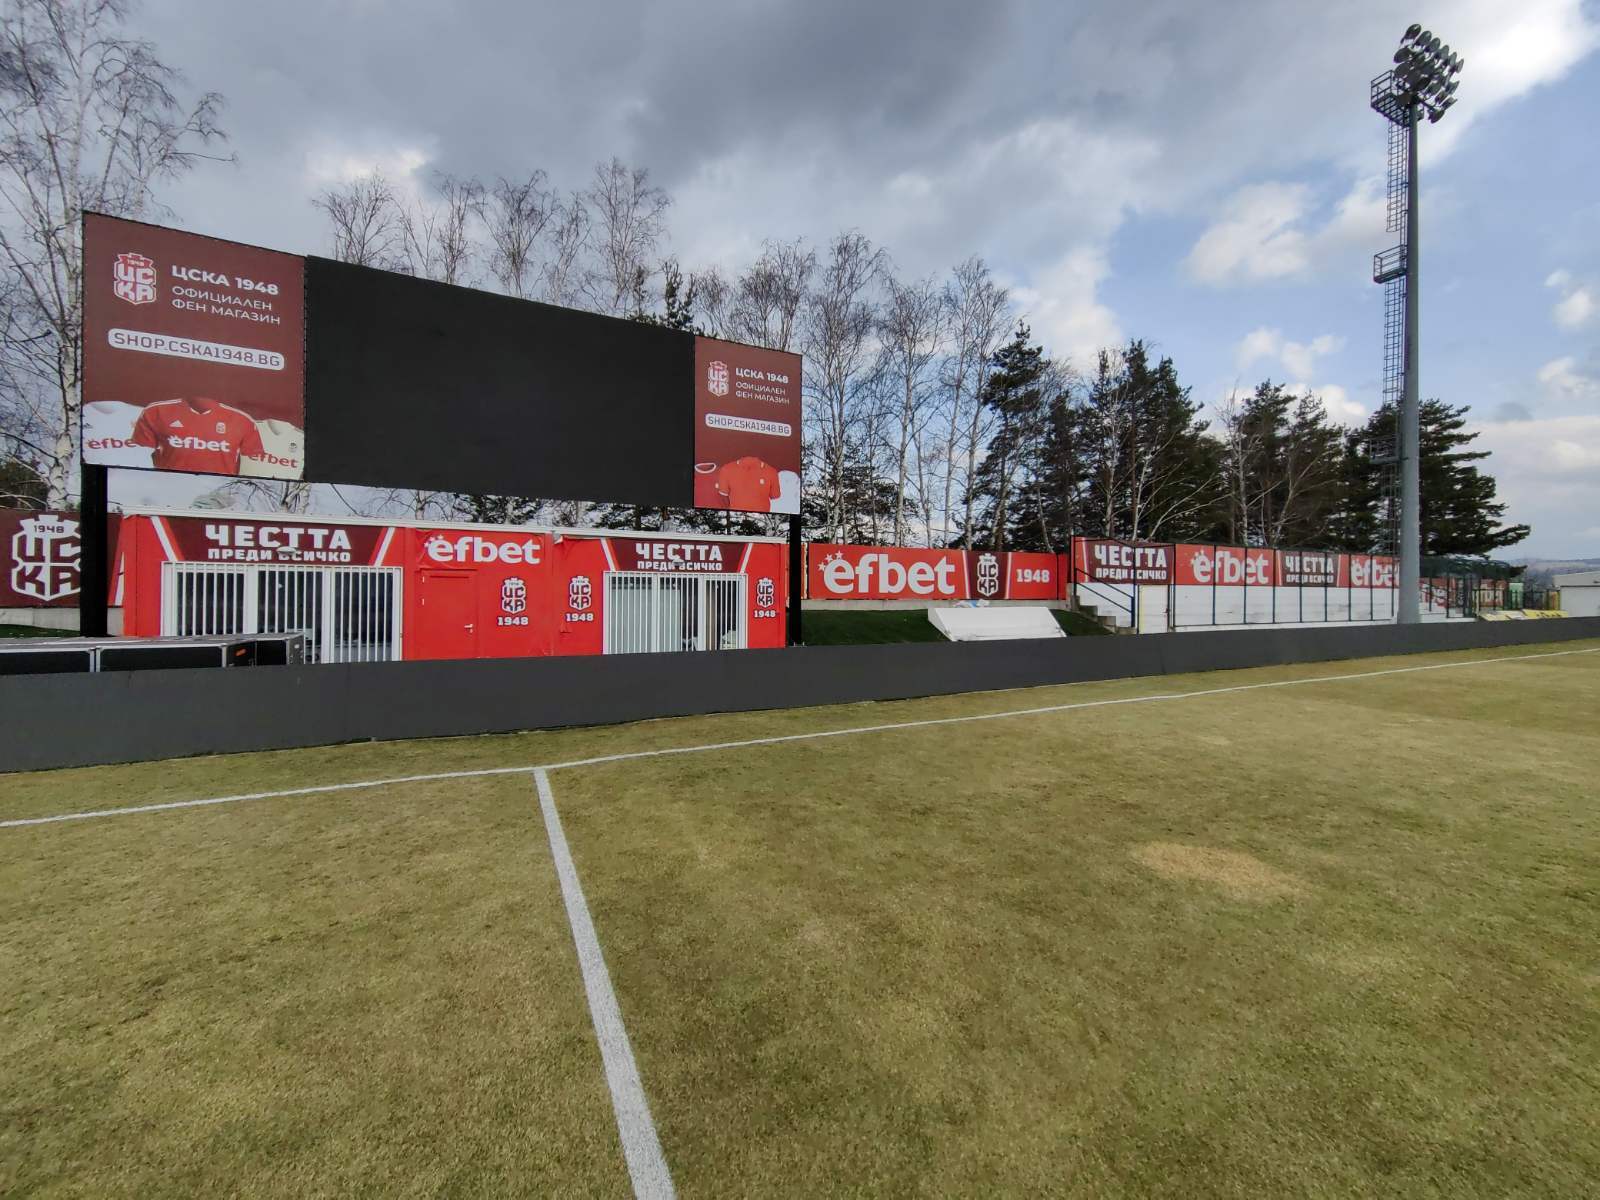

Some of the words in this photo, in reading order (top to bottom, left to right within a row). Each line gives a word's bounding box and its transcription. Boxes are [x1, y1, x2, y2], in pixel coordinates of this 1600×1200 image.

[171, 265, 230, 287] ЦСКА
[235, 277, 280, 295] 1948
[172, 286, 272, 311] ОФИЦИАЛЕН
[172, 299, 206, 312] ФЕН
[211, 305, 281, 325] МАГАЗИН
[114, 332, 280, 367] SHOP.CSKA1948.BG
[735, 367, 765, 381] ЦСКА
[766, 372, 789, 384] 1948
[735, 381, 786, 395] ОФИЦИАЛЕН
[735, 390, 753, 399] ФЕН
[754, 393, 790, 405] МАГАЗИН
[708, 416, 790, 435] SHOP.CSKA1948.BG
[168, 436, 230, 452] efbet
[34, 525, 65, 533] 1948
[205, 524, 352, 550] ЧЕСТТА
[208, 548, 272, 562] ПРЕДИ
[426, 536, 541, 565] efbet
[635, 543, 723, 561] ЧЕСТТА
[823, 553, 956, 595] efbet
[1016, 568, 1050, 583] 1948
[1095, 567, 1128, 580] ПРЕДИ
[1192, 551, 1269, 584] efbet
[497, 616, 529, 626] 1948
[566, 613, 594, 622] 1948
[754, 610, 776, 618] 1948
